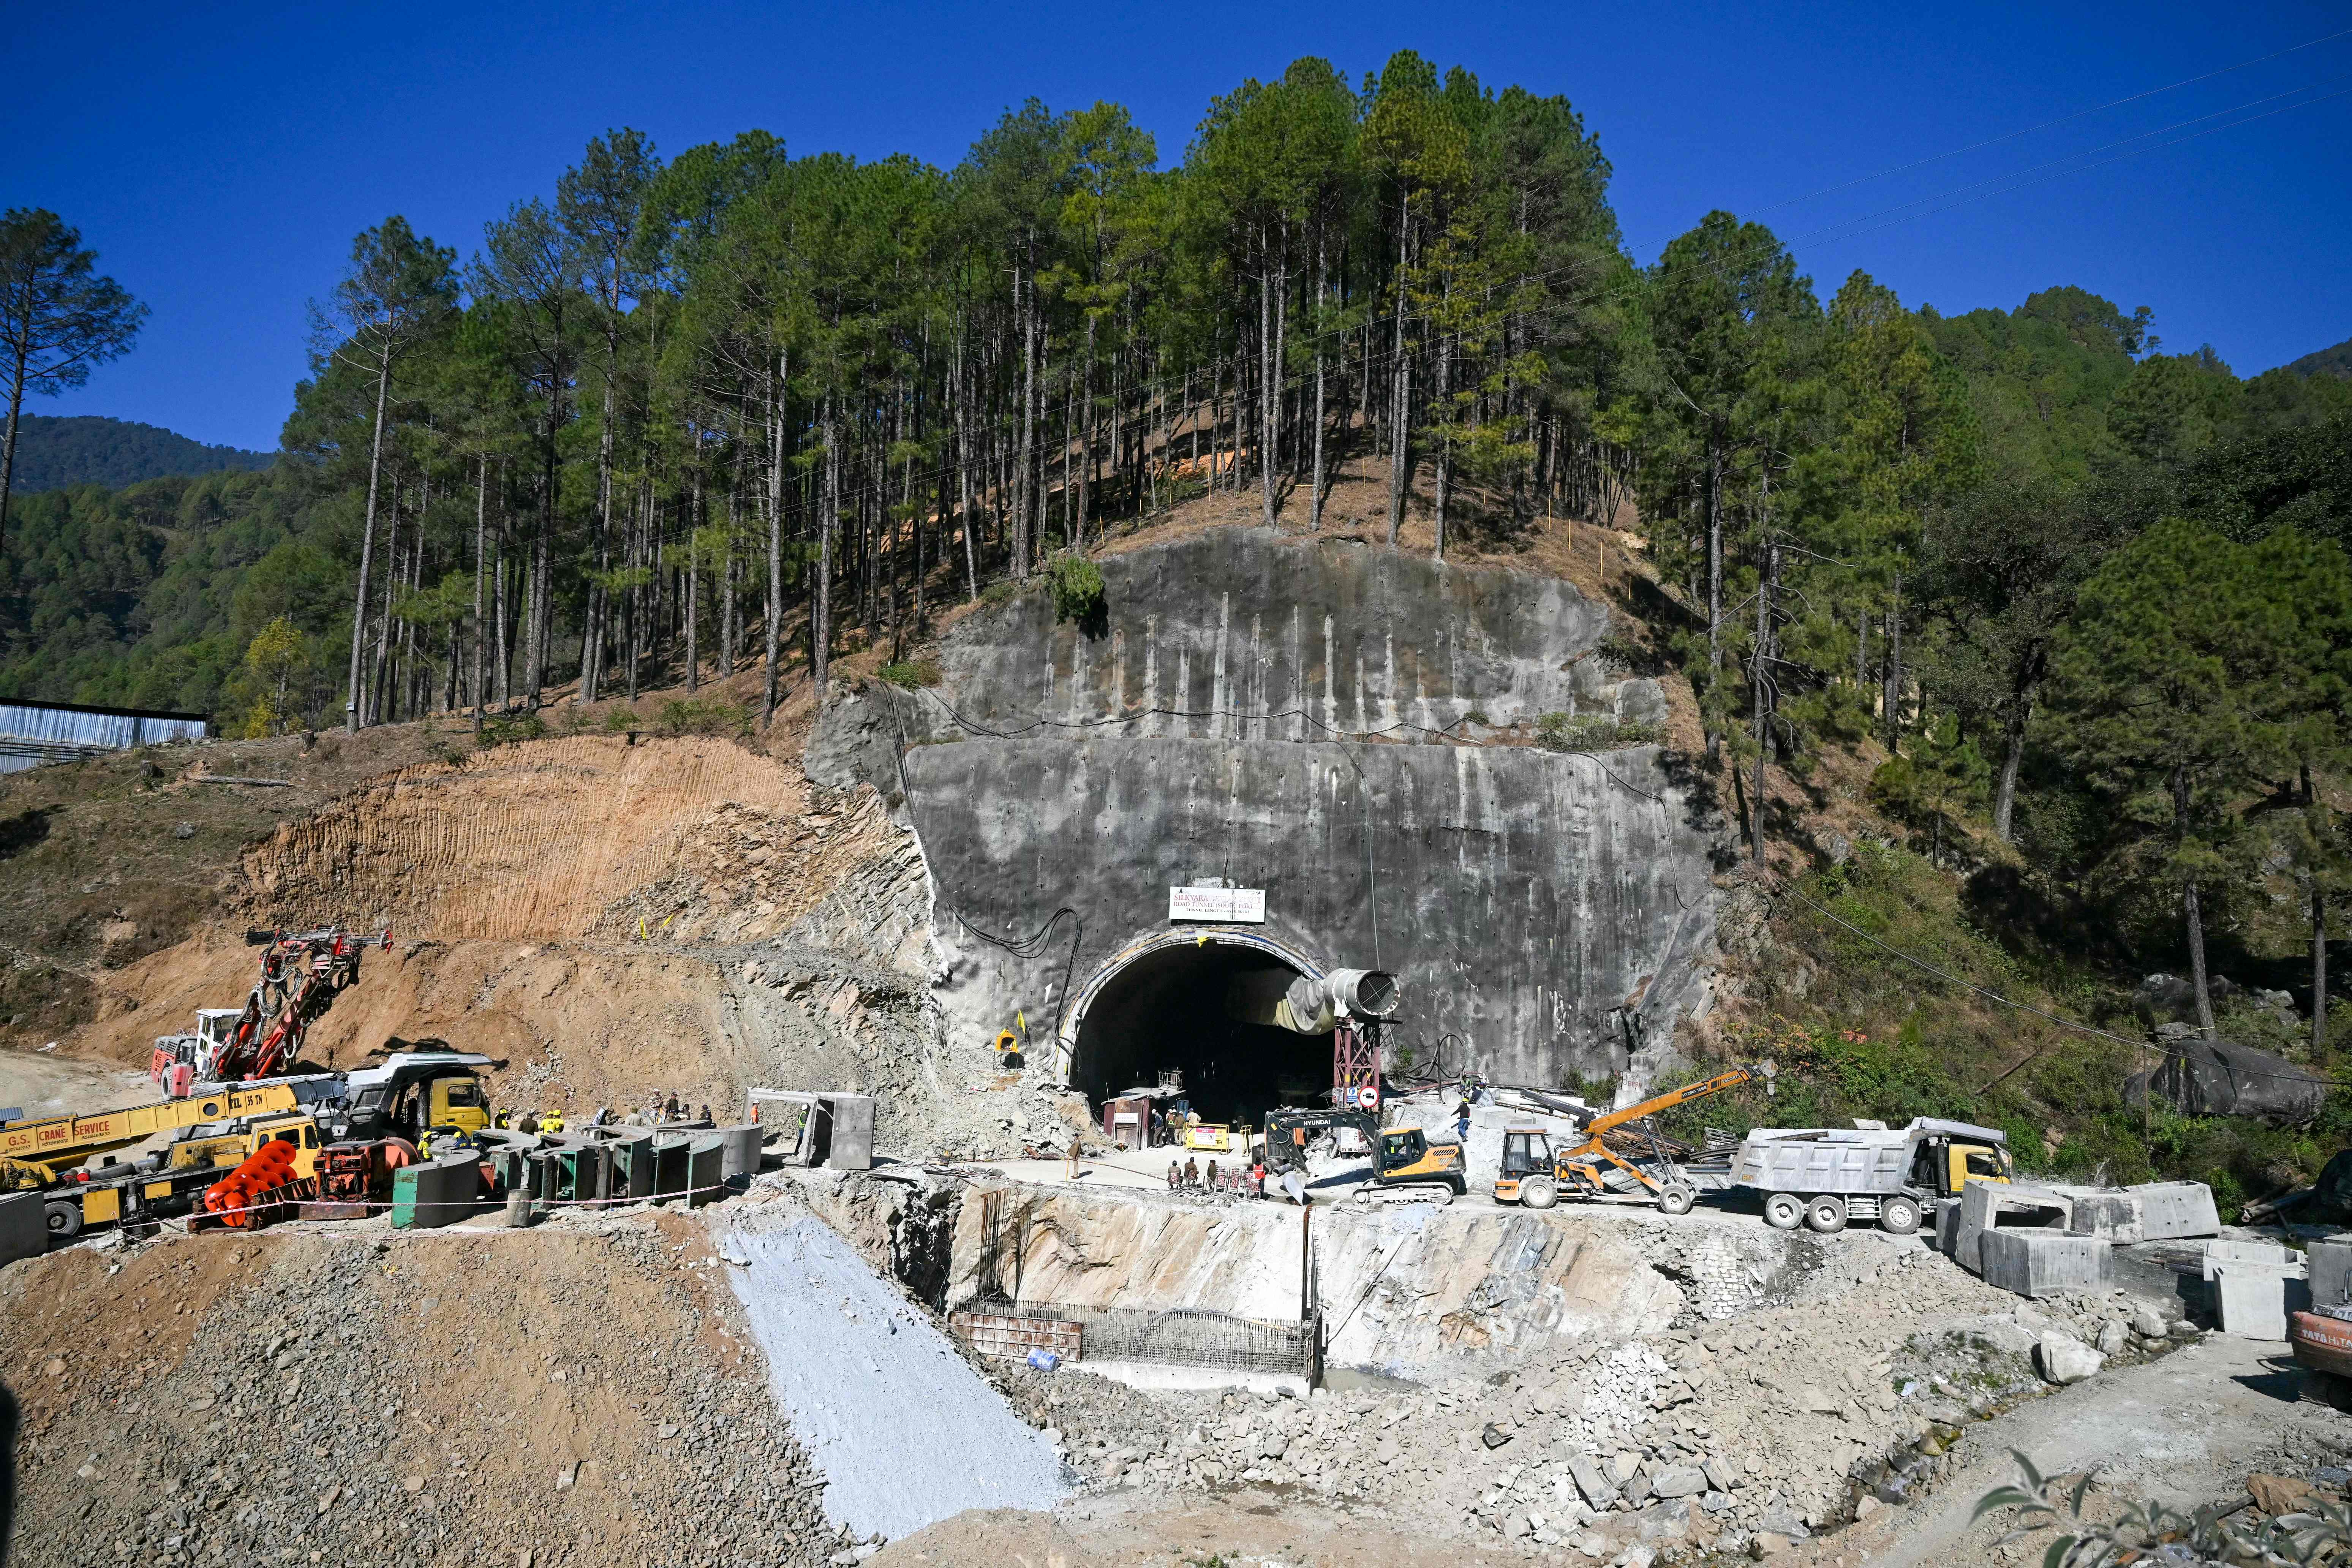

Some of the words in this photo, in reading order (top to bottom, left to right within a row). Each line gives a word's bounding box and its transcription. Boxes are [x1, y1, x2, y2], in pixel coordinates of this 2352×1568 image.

[1722, 1074, 1740, 1083] ESCORTS
[247, 1095, 253, 1106] 35
[255, 1094, 262, 1105] TN
[8, 1134, 30, 1146] G.S.
[39, 1128, 66, 1141] CRANE
[75, 1121, 109, 1136] SERVICE
[2303, 1329, 2327, 1343] TATA
